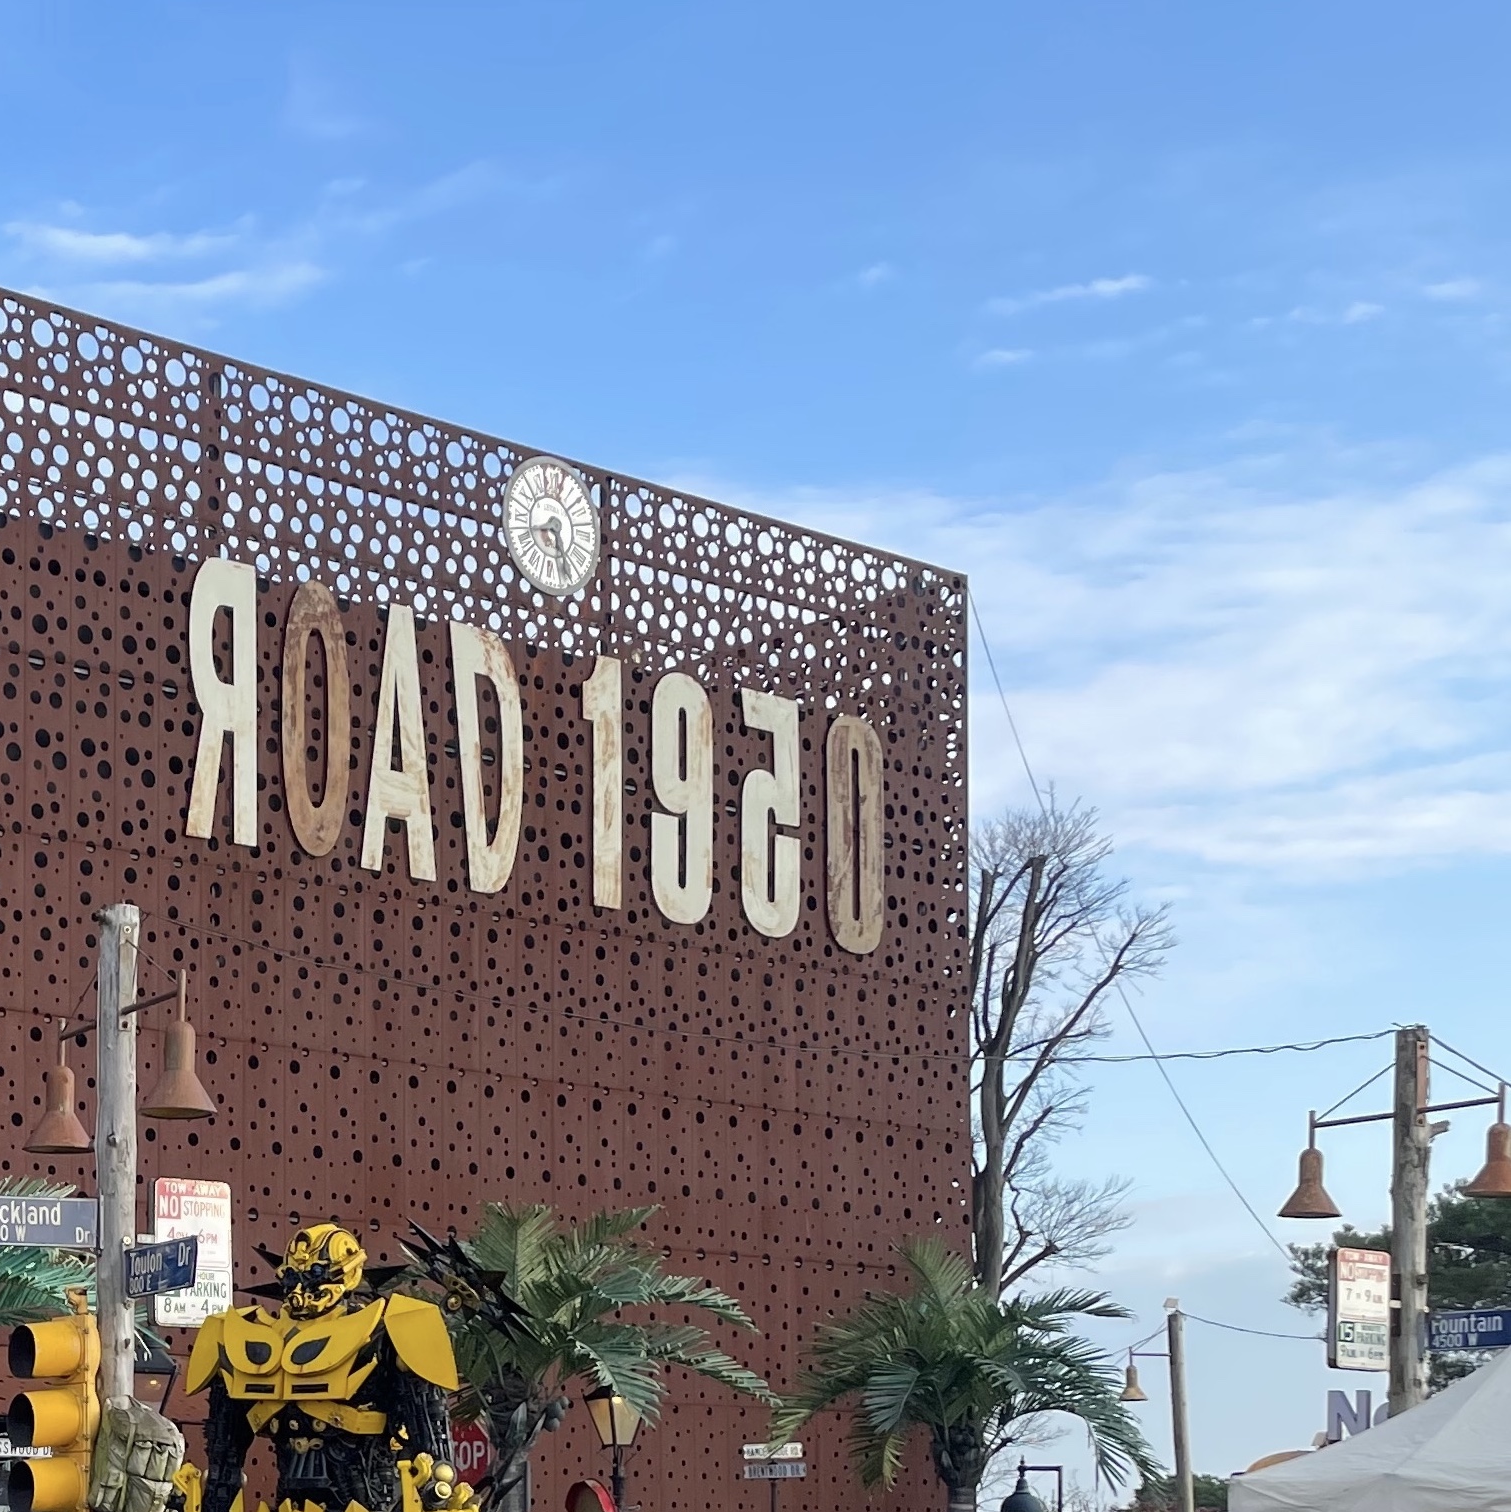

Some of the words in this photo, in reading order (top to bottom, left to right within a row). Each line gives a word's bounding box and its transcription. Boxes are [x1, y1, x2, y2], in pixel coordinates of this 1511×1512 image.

[185, 556, 524, 895] ROAD
[582, 654, 884, 956] 1950
[159, 1196, 180, 1217] NO
[15, 1225, 26, 1242] W
[75, 1226, 92, 1243] Dr
[130, 1252, 163, 1277] Toulon
[178, 1241, 192, 1267] Dr
[1340, 1261, 1354, 1280] NO
[1339, 1323, 1353, 1341] 15
[1431, 1314, 1503, 1334] Fountain
[1432, 1334, 1462, 1348] 4500
